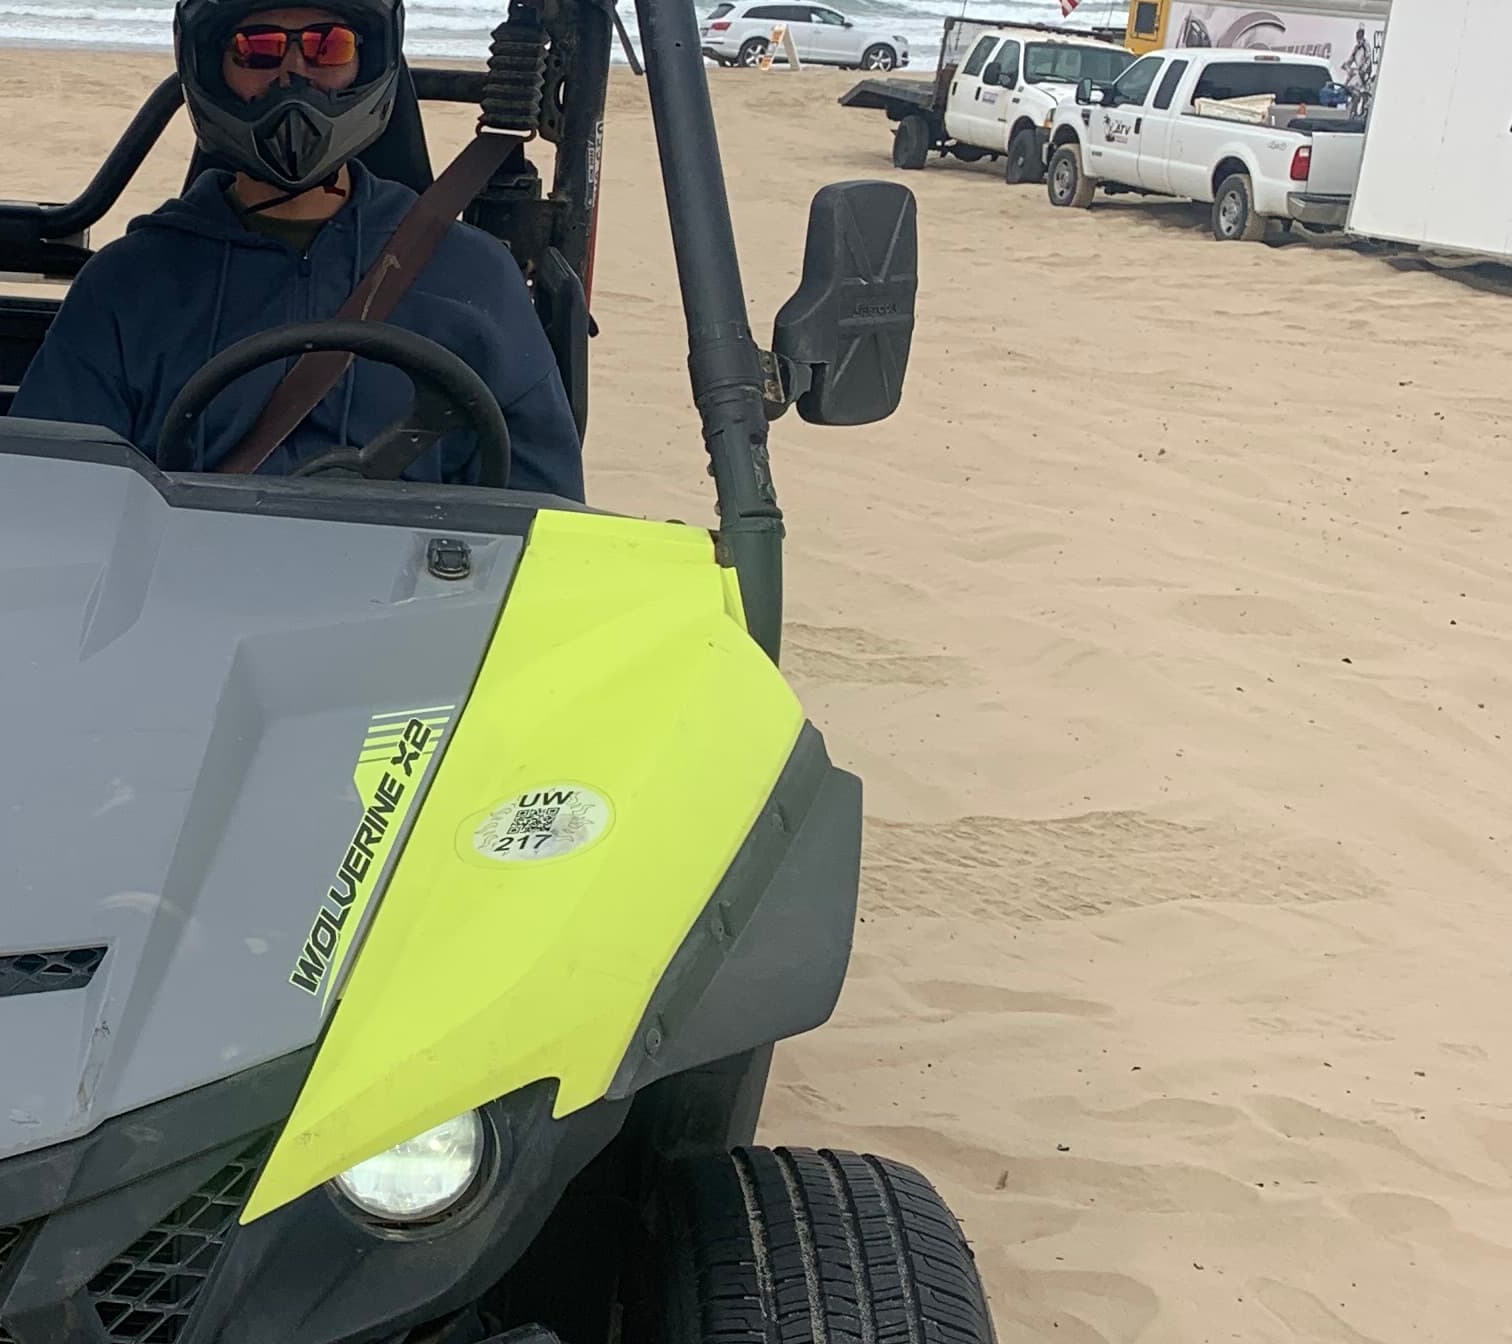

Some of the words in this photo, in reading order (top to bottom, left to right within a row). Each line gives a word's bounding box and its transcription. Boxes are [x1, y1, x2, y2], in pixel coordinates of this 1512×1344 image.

[518, 790, 574, 807] UW
[494, 834, 553, 852] 217
[291, 771, 404, 993] WOLVERINE
[391, 718, 431, 776] X2
